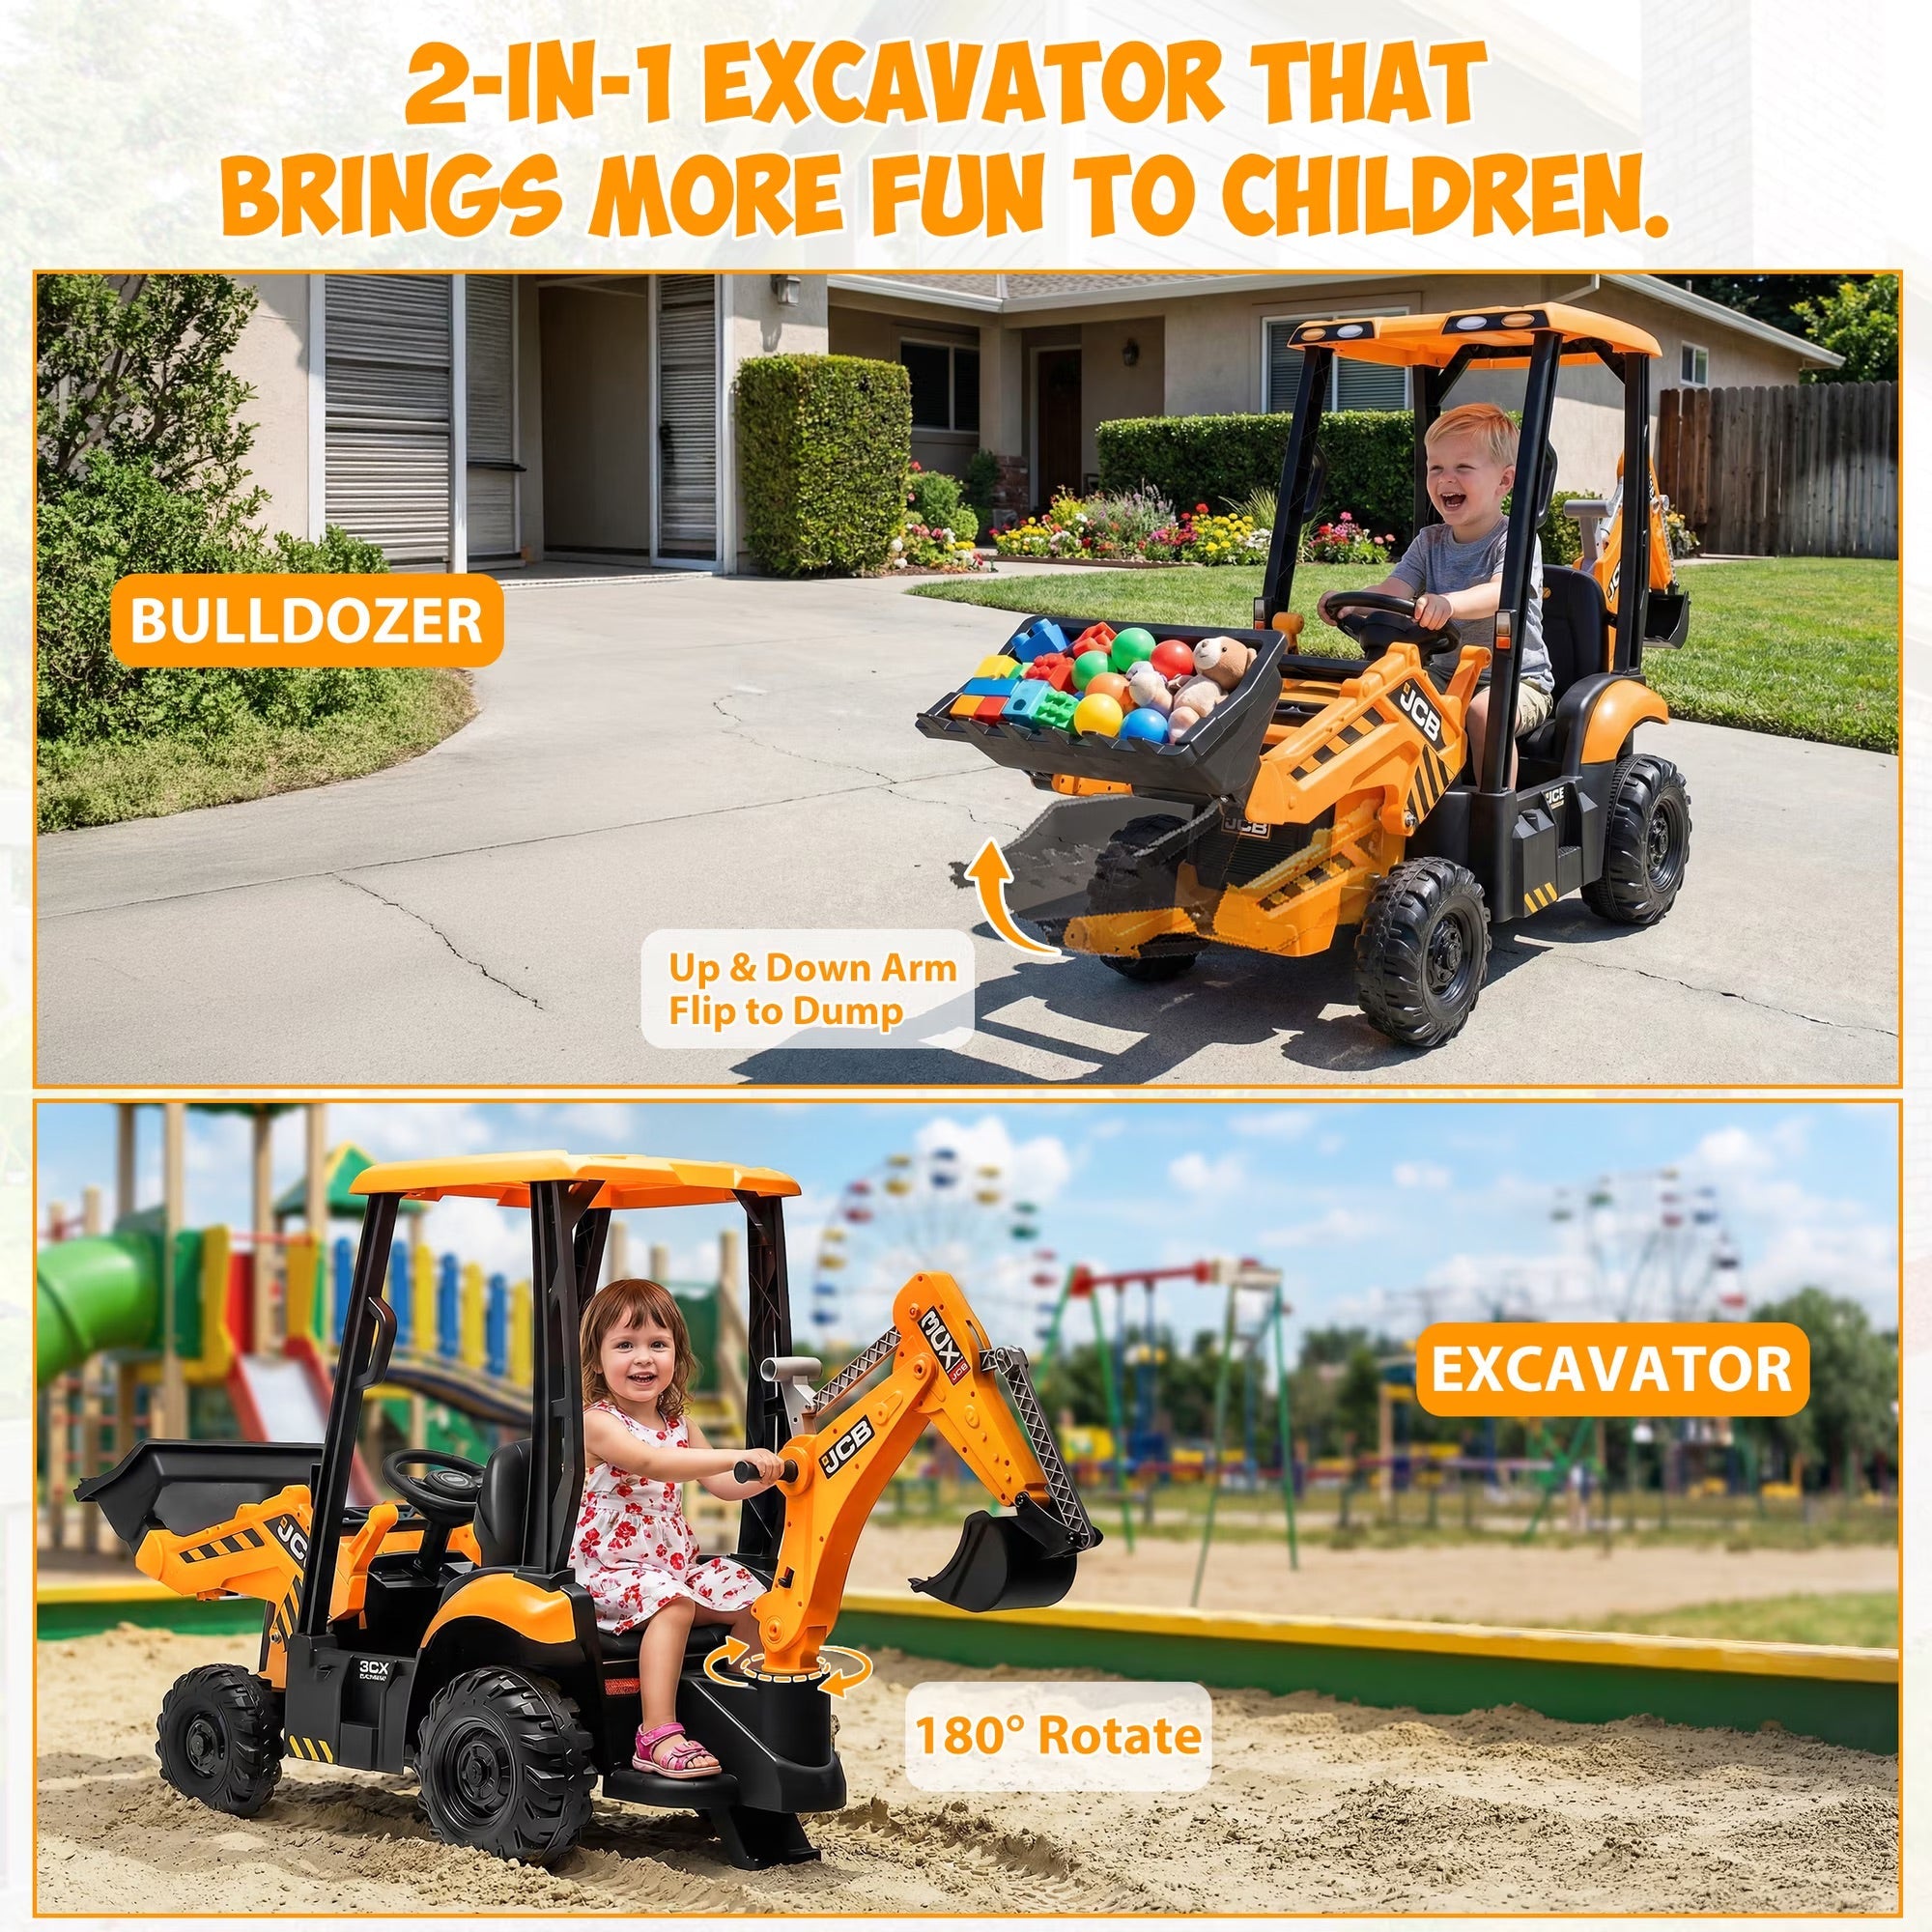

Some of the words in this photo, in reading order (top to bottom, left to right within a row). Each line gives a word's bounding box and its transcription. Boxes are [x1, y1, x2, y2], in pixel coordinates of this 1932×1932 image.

[1400, 689, 1441, 742] JCB
[1224, 817, 1267, 835] JCB
[825, 1420, 872, 1474] JCB
[277, 1524, 308, 1568] JC
[359, 1660, 389, 1675] 3CX
